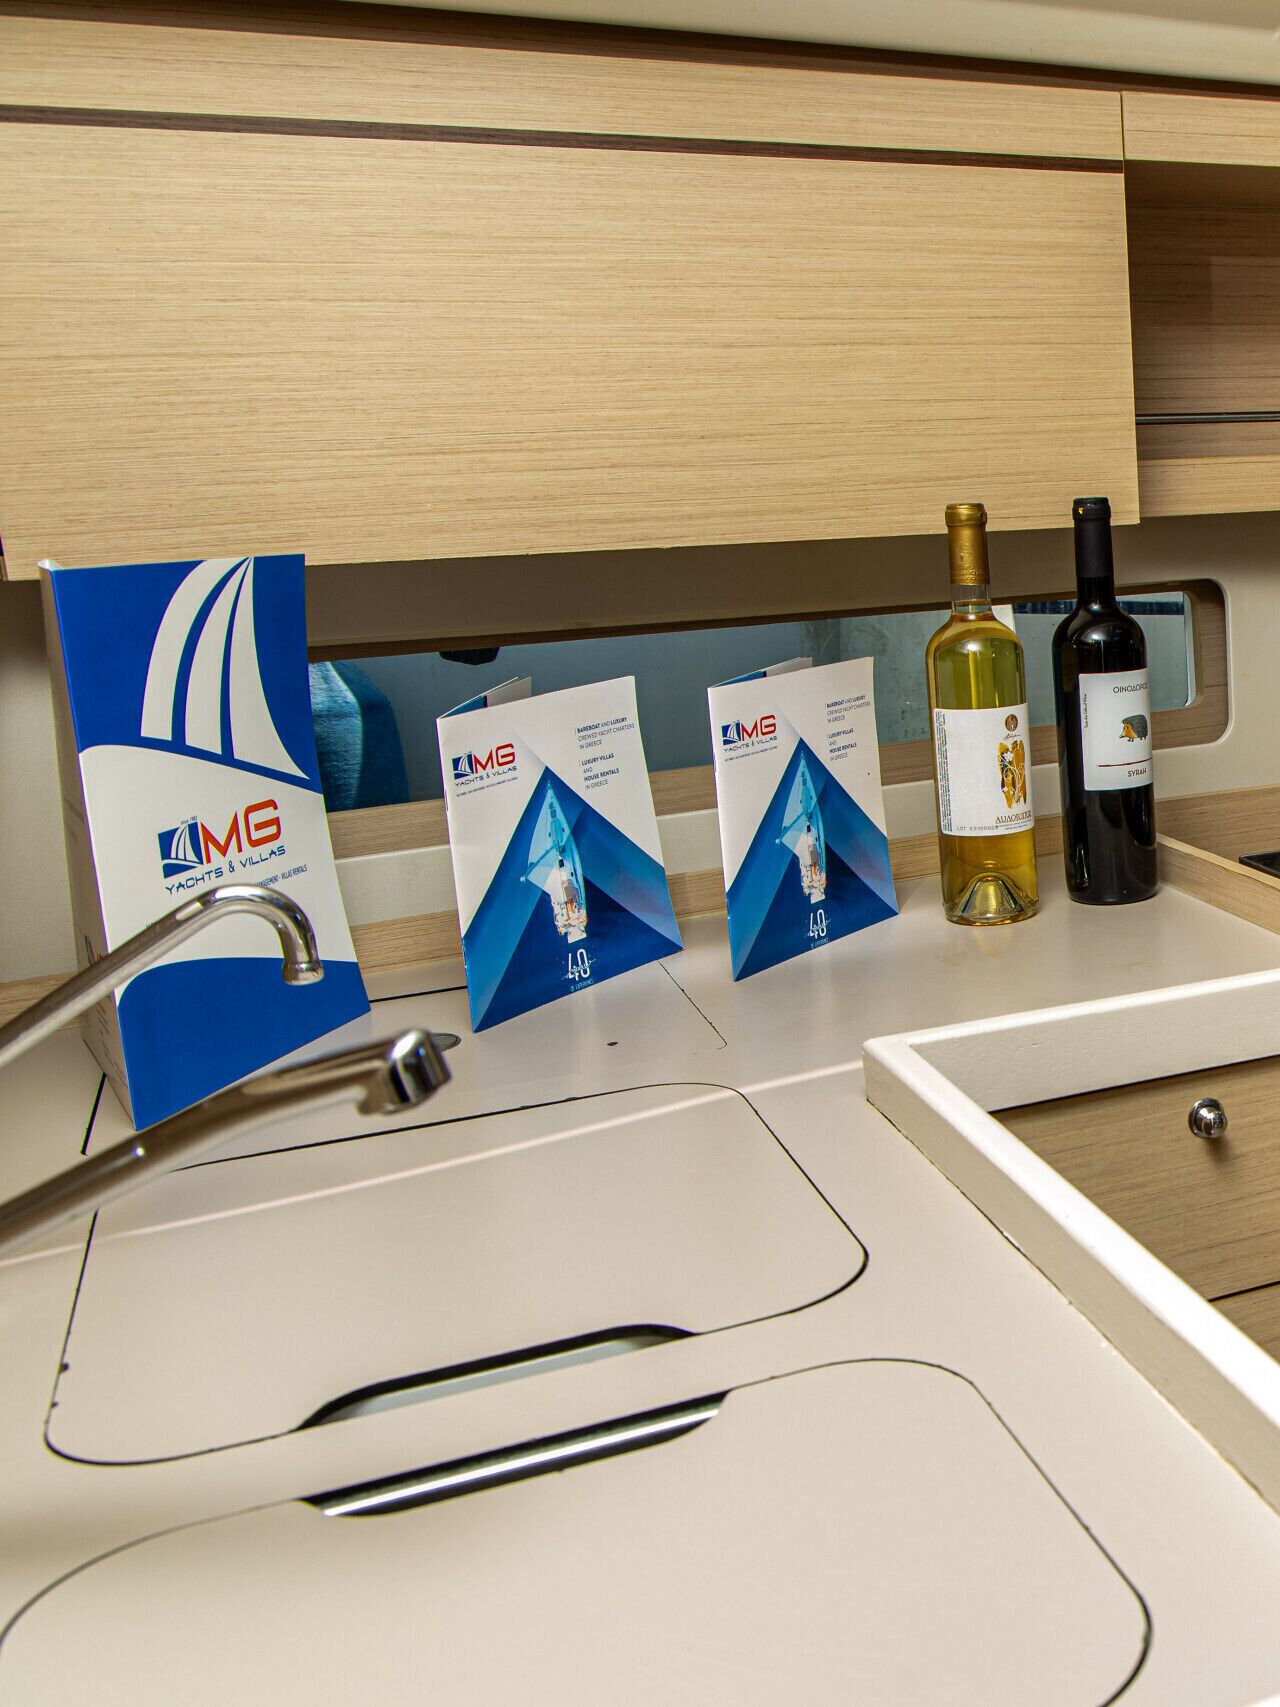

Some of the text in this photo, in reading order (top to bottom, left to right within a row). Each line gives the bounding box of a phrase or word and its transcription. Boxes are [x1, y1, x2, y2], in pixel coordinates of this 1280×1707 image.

[577, 723, 600, 733] BAREBOAT
[611, 717, 627, 725] LUXURY
[578, 732, 598, 741] CREWED
[613, 723, 634, 732] CHARTERS
[585, 739, 602, 748] GREECE
[582, 753, 614, 765] LUXURY VILLAS
[455, 775, 484, 787] YACHTS
[492, 765, 517, 776] VILLAS
[584, 768, 619, 781] HOUSE RENTALS
[1128, 768, 1146, 777] SYRAH
[591, 779, 608, 788] GREECE
[165, 845, 286, 895] YACHTS & VILLAS
[569, 949, 590, 981] 40
